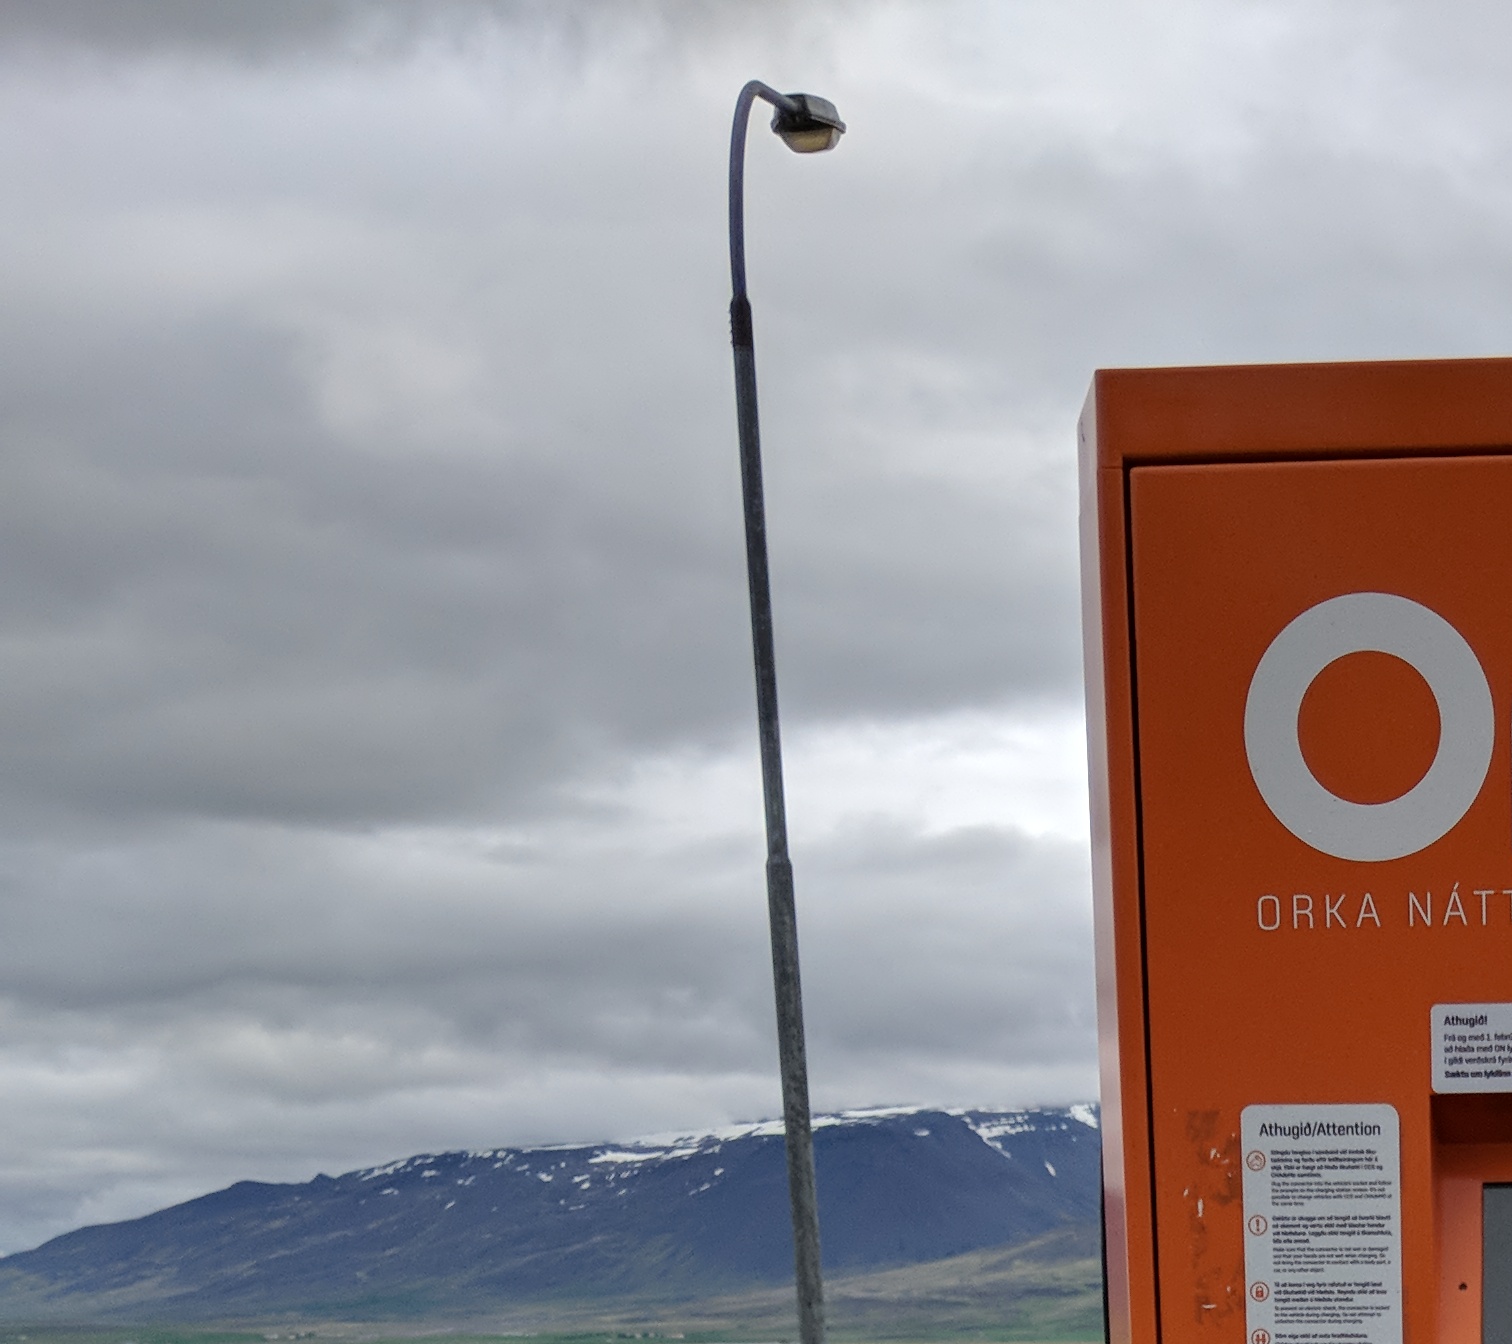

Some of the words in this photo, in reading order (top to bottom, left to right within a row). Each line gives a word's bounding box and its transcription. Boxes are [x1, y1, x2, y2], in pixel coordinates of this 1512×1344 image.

[1256, 891, 1382, 931] ORKA
[1444, 1015, 1488, 1028] Athugið!
[1259, 1121, 1381, 1140] Athugið/Attention
